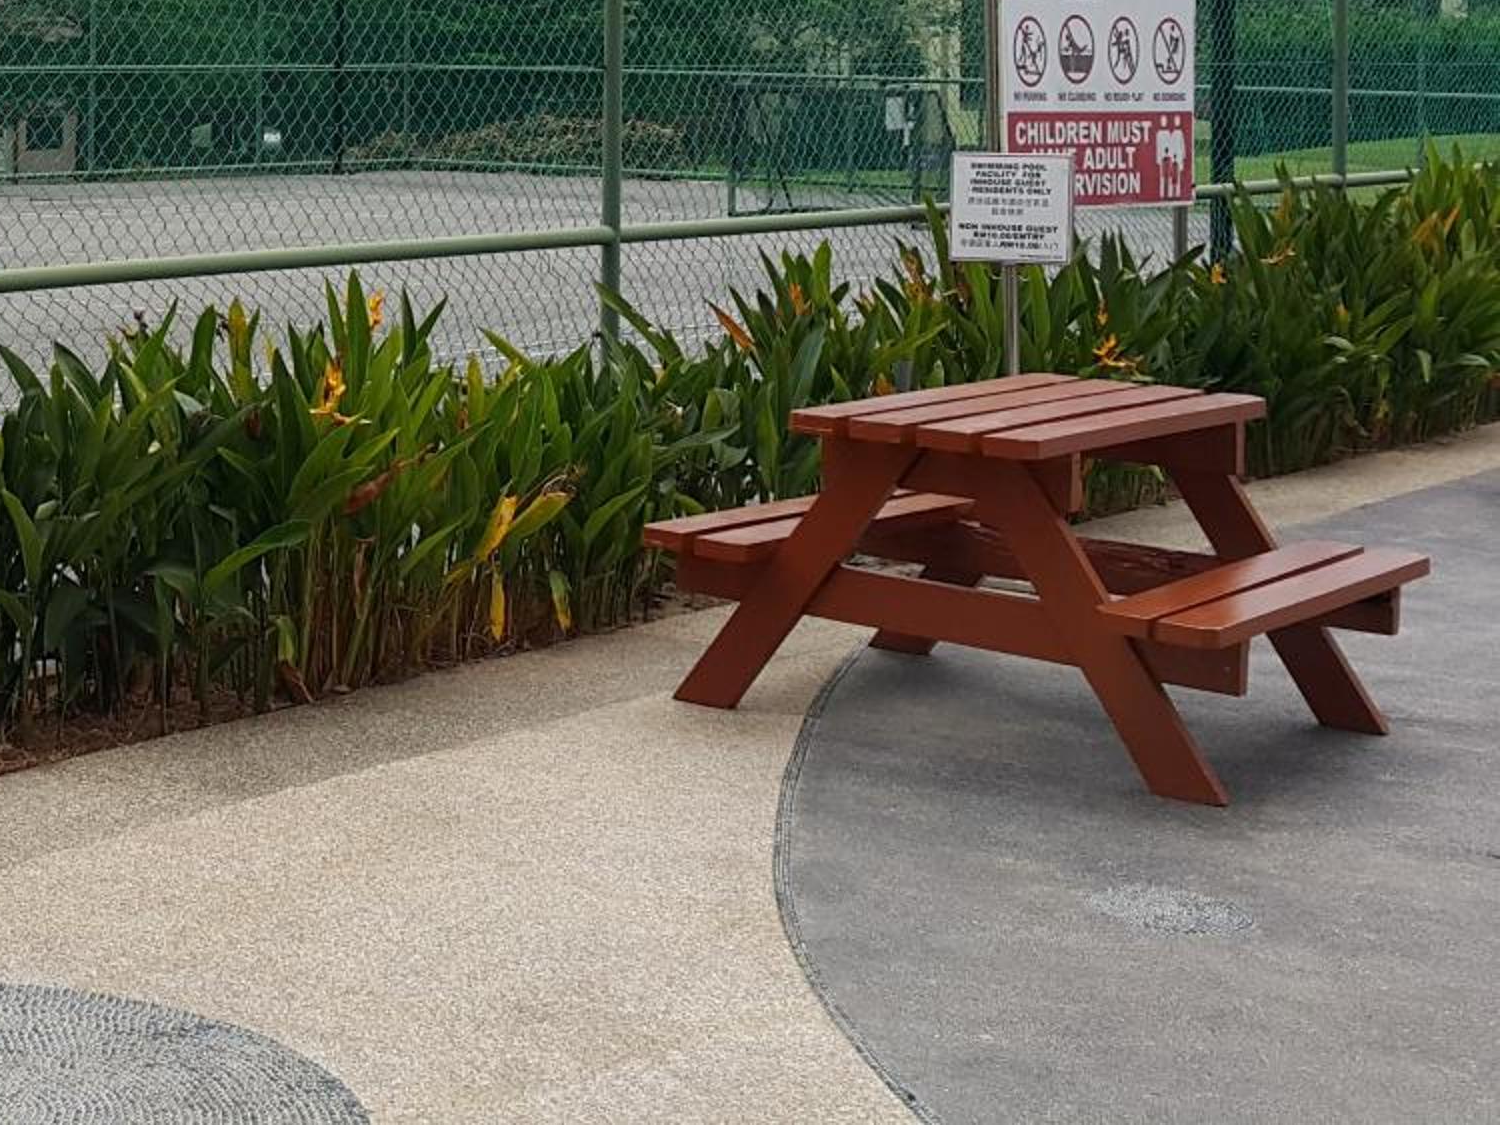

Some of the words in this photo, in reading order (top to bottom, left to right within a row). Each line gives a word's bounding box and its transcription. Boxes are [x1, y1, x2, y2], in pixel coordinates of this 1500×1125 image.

[1014, 120, 1102, 146] CHILDREN
[1106, 119, 1153, 144] MUST
[1083, 146, 1137, 170] ADULT
[971, 162, 1019, 170] SWIMMING
[1021, 163, 1048, 172] POOL
[1022, 171, 1042, 179] FOR
[1014, 180, 1047, 188] GUEST
[1074, 171, 1141, 196] RVISION
[1026, 188, 1052, 196] ONLY
[958, 222, 979, 230] NON
[981, 223, 1023, 232] INHOUSE
[1025, 225, 1059, 234] GUEST
